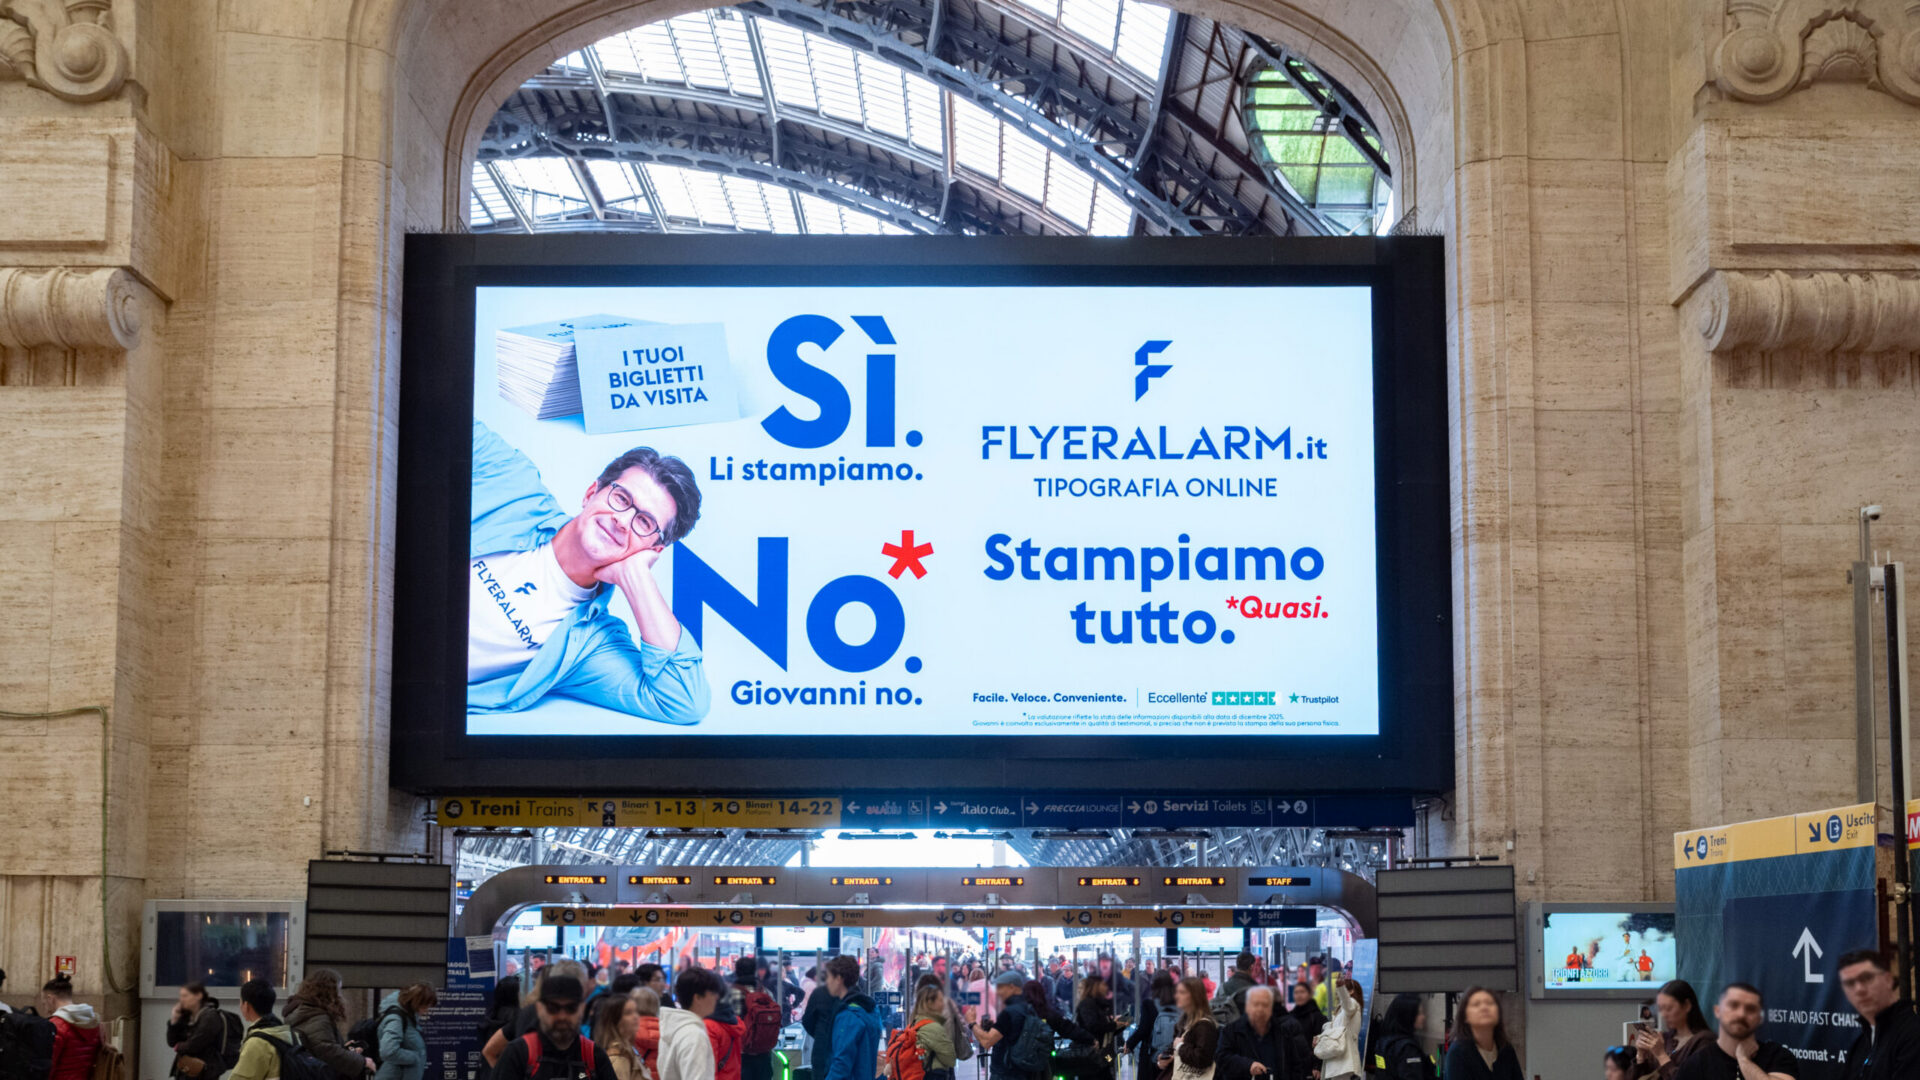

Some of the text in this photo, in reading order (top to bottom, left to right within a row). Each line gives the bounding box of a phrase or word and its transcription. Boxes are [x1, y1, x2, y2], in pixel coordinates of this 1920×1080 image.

[622, 345, 685, 367] I TUOI
[608, 364, 704, 389] BIGLIETTI
[760, 313, 924, 449] Sì.
[610, 386, 709, 410] DA VISITA
[982, 425, 1328, 460] FLYERALARM.it
[710, 456, 924, 486] Li stampiamo.
[1034, 478, 1278, 497] TIPOGRAFIA ONLINE
[983, 533, 1325, 593] Stampiamo
[472, 560, 539, 650] FLYERALARM
[1070, 600, 1236, 644] tutto.
[731, 680, 923, 705] Giovanni no.
[972, 693, 1008, 703] Facile.
[1011, 693, 1050, 703] Veloce.
[1053, 693, 1127, 703] Conveniente.
[1301, 695, 1340, 706] Trustpilot
[470, 800, 574, 817] Treni Trains
[621, 801, 833, 815] Binari 1-13 Binari 14-22
[1163, 800, 1246, 812] Servizi Toilets
[1710, 833, 1727, 847] Treni
[1846, 829, 1858, 840] Exit
[558, 876, 593, 884] ENTRATA
[643, 876, 678, 884] ENTRATA
[727, 877, 762, 885] ENTRATA
[844, 877, 879, 885] ENTRATA
[975, 878, 1010, 886] ENTRATA
[1092, 878, 1127, 886] ENTRATA
[1177, 877, 1212, 886] ENTRATA
[1266, 877, 1292, 885] STAFF
[582, 909, 605, 917] Treni
[665, 909, 688, 918] Treni
[749, 910, 773, 918] Treni
[1098, 911, 1122, 919] Treni
[1190, 911, 1214, 919] Treni
[1258, 911, 1280, 919] Staff
[1768, 1009, 1862, 1027] BEST AND FAST CHAN
